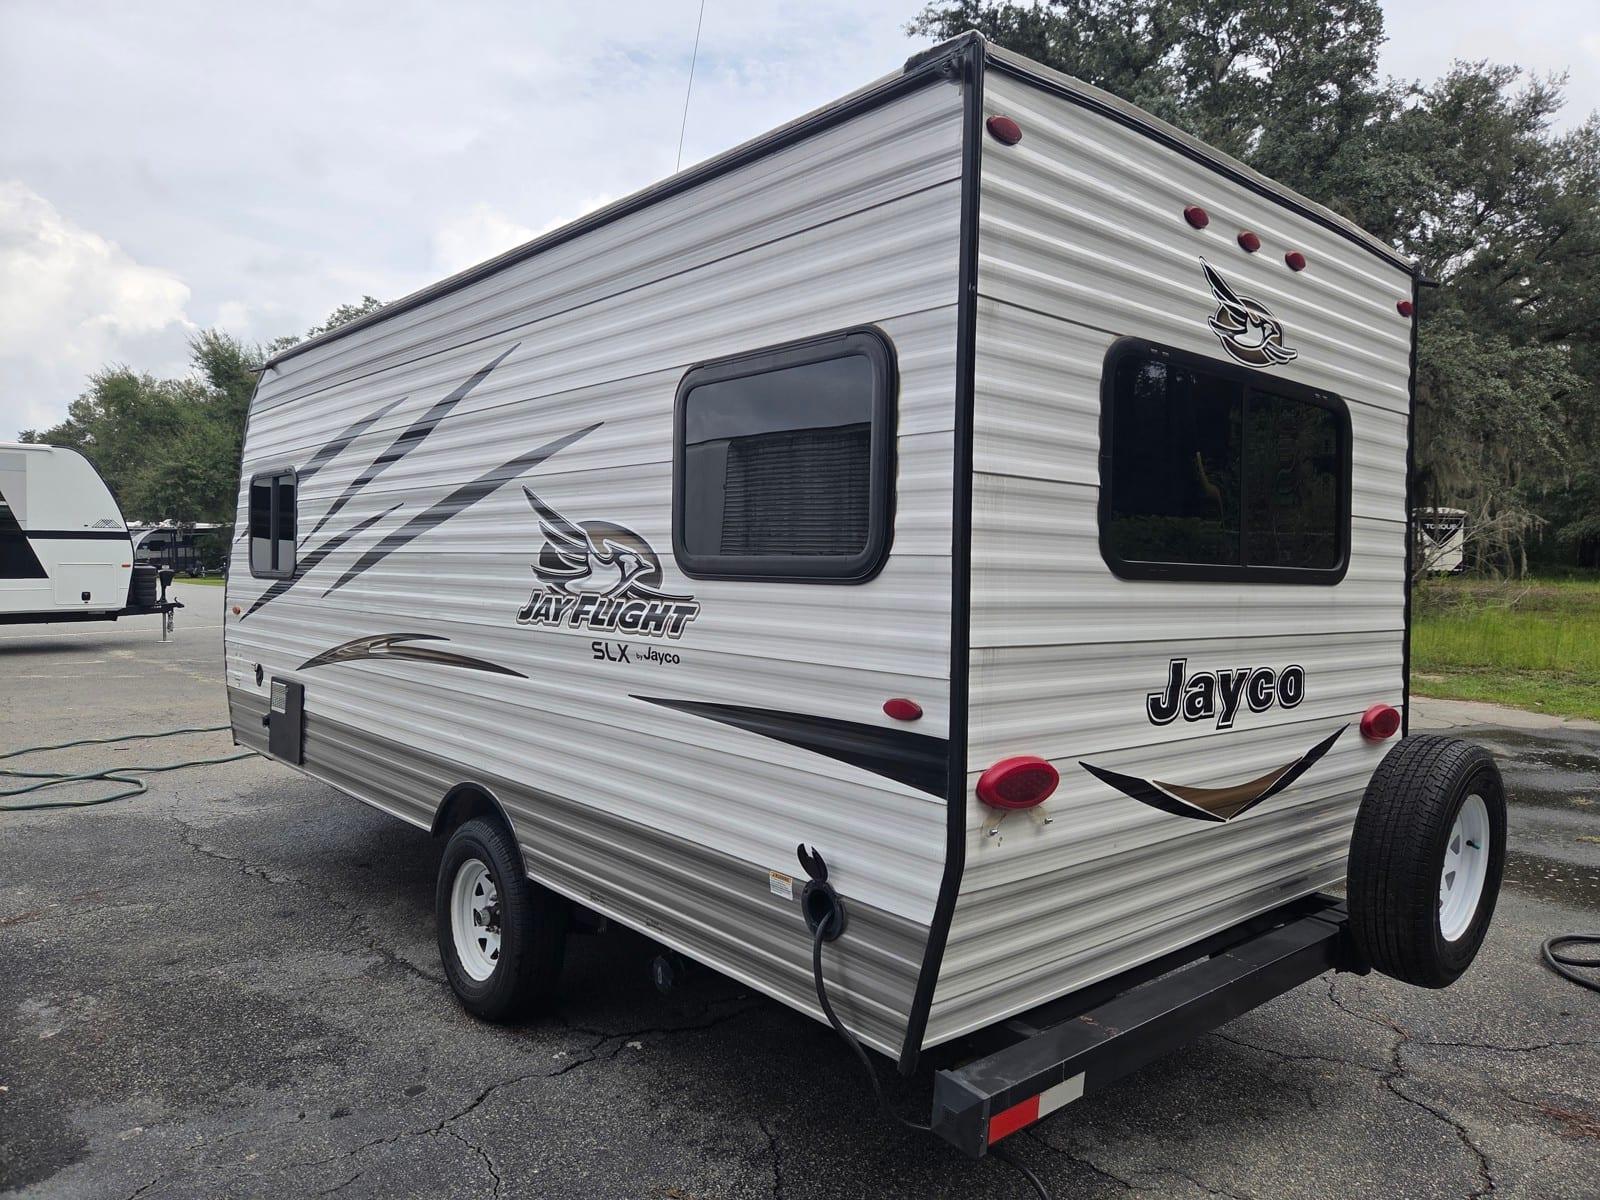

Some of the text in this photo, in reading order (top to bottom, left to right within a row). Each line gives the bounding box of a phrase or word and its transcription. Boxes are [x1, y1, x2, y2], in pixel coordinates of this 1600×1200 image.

[516, 589, 700, 640] JAY FLIGHT
[592, 641, 631, 664] SLX
[643, 646, 680, 665] Jayco
[1146, 658, 1305, 730] Jayco
